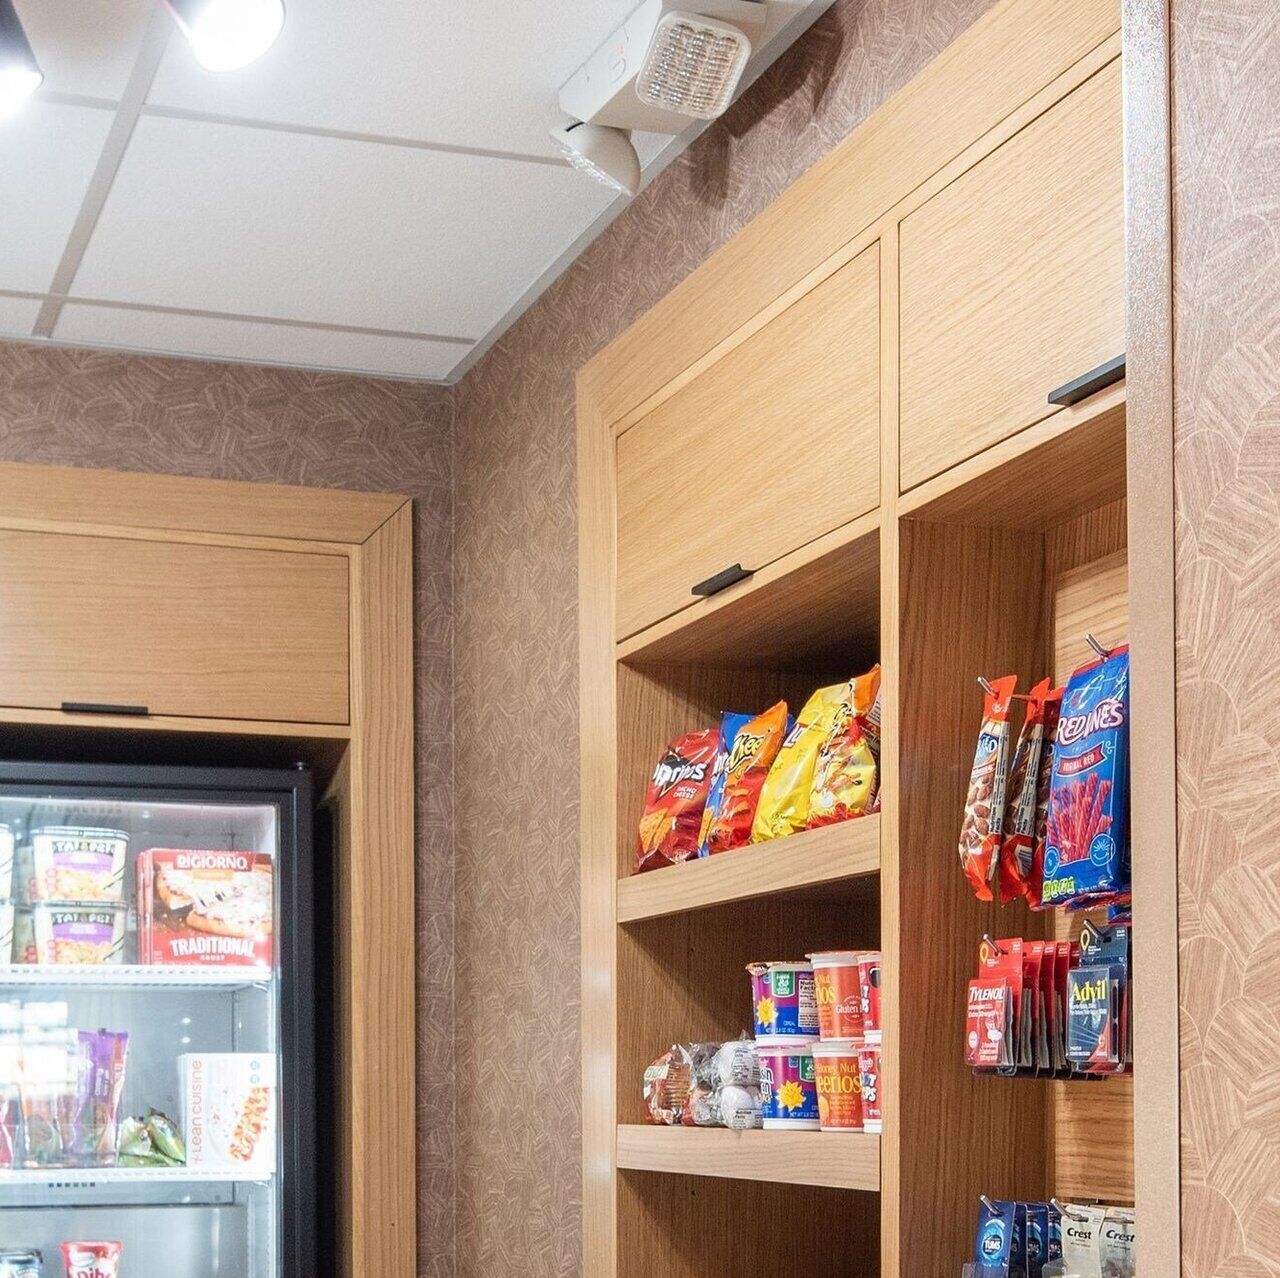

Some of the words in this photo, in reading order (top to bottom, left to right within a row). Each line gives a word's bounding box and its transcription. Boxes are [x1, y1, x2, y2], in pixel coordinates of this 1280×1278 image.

[170, 936, 256, 958] TRADITIONAL
[969, 986, 1005, 1003] TYLENOL
[1073, 979, 1106, 1001] Advil
[835, 1004, 859, 1014] Gluten
[840, 1063, 857, 1073] Nut
[1067, 1227, 1092, 1240] Crest
[1106, 1229, 1136, 1243] Crest
[984, 1240, 1001, 1250] TUMS
